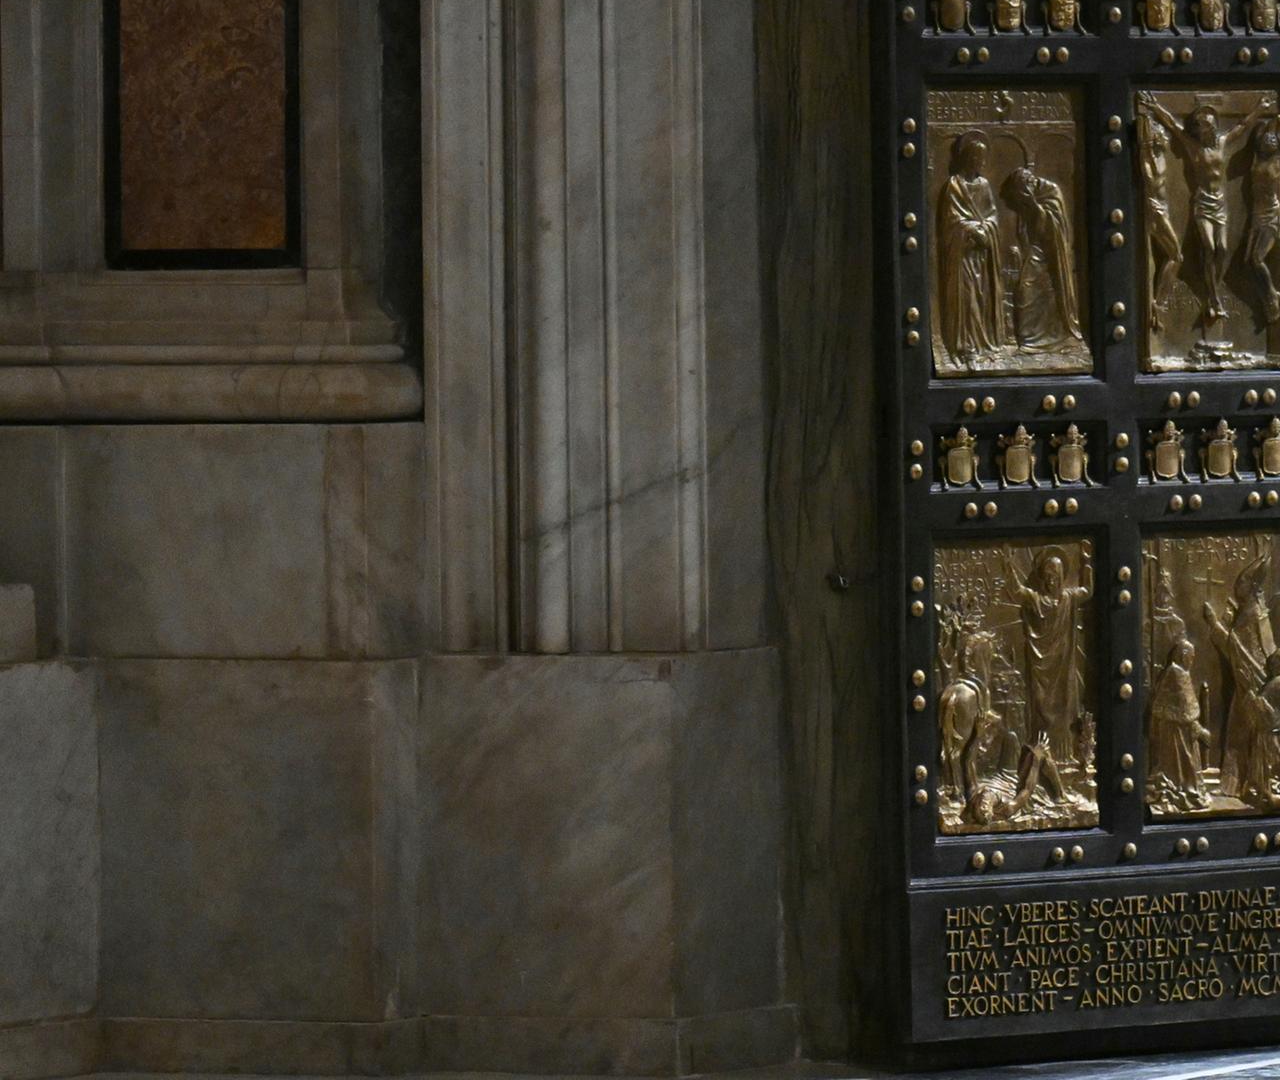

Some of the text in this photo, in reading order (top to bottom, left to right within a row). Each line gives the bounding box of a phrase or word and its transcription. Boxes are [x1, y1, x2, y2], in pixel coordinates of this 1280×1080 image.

[945, 905, 995, 927] HINC
[1004, 900, 1080, 923] VBERES
[1089, 892, 1189, 918] SCATEANT
[1200, 886, 1277, 912] DIVINAE
[945, 928, 993, 950] TIAE
[1004, 922, 1081, 946] LATICES
[1098, 912, 1219, 939] OMNIVMQVE
[946, 951, 999, 972] TIVM
[1011, 943, 1093, 968] ANIMOS
[1106, 935, 1193, 962] EXPIENT
[1210, 931, 1272, 953] ALMA
[947, 972, 1012, 995] CIANT
[1030, 967, 1080, 989] PACE
[1096, 955, 1221, 984] CHRISTIANA
[946, 990, 1058, 1018] EXORNENT
[1079, 984, 1143, 1008] ANNO
[1158, 977, 1224, 1002] SACRO
